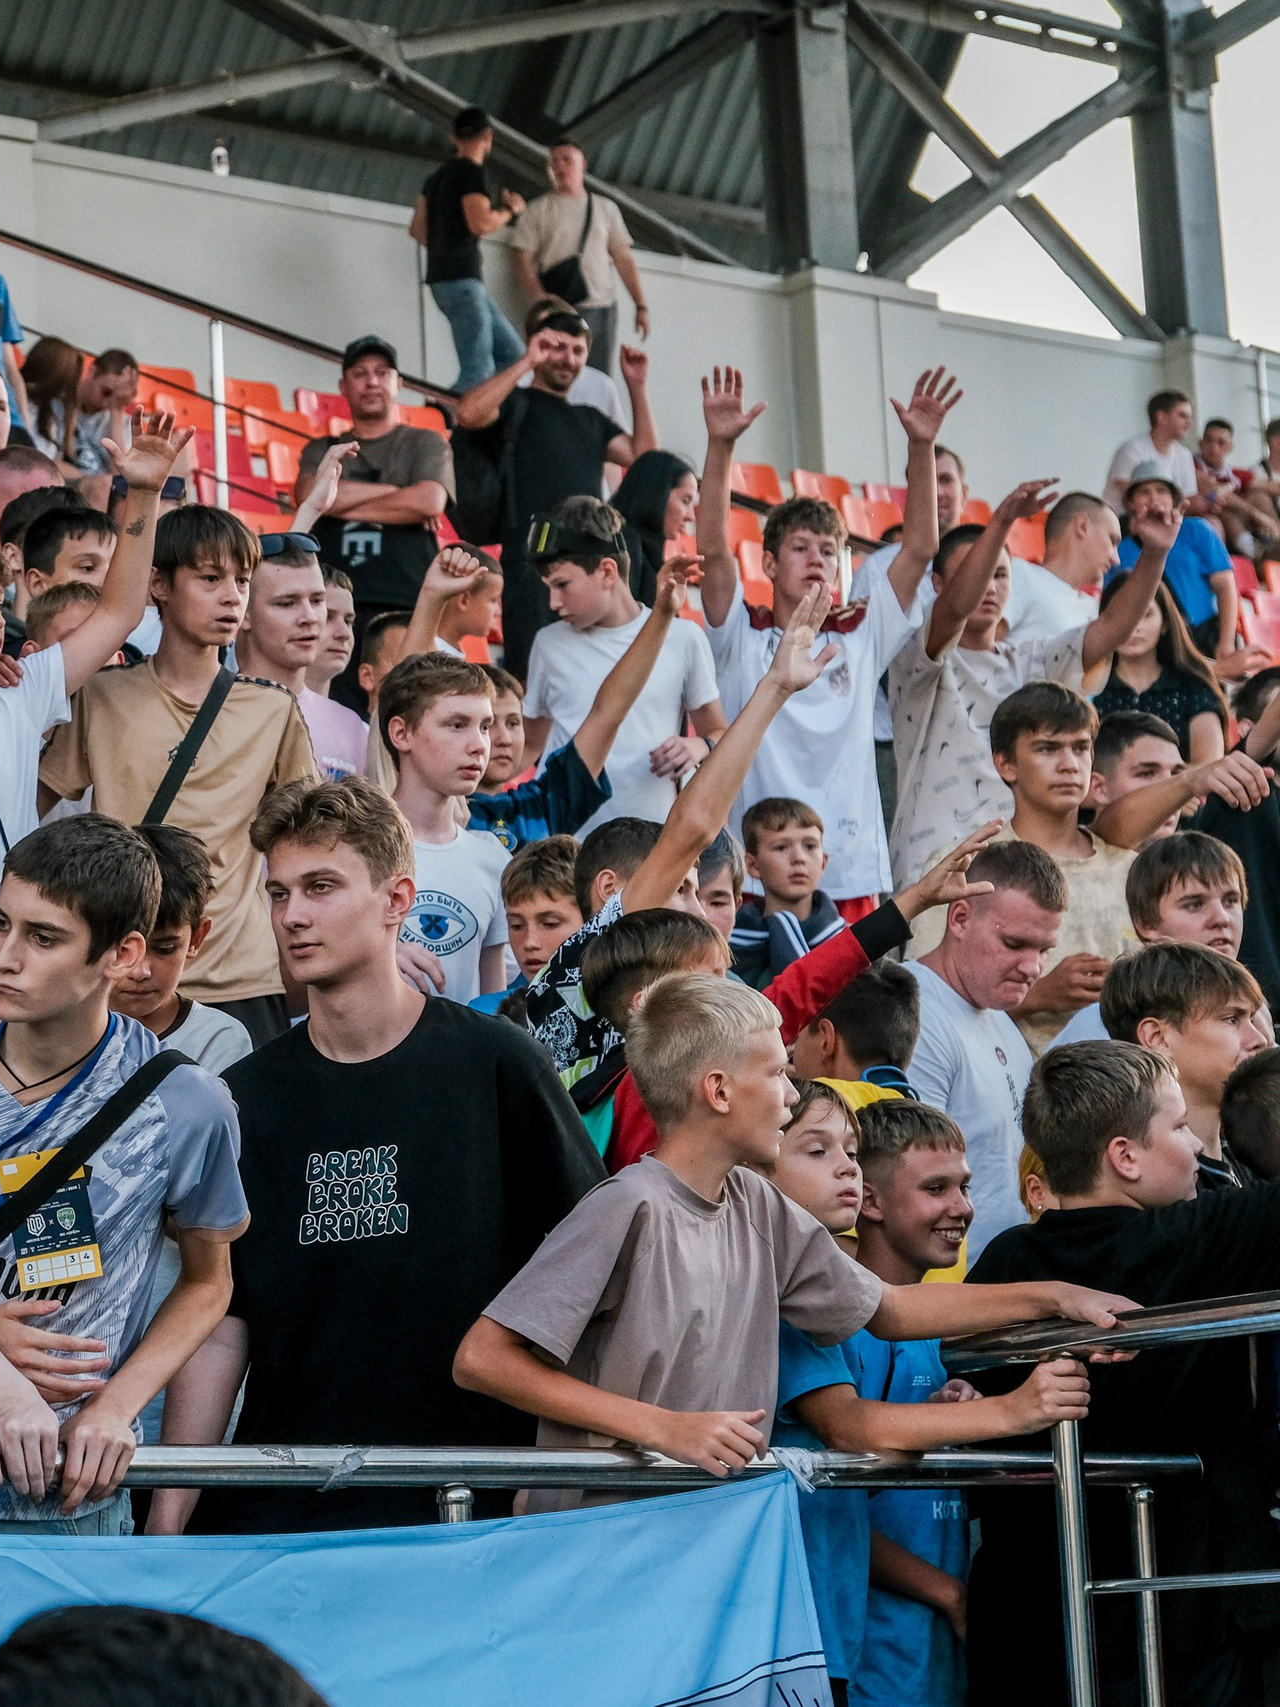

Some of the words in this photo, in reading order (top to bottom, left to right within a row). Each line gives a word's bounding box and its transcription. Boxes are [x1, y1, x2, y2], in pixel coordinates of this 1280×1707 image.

[437, 895, 463, 914] БЫТЬ
[306, 1144, 399, 1183] BREAK
[308, 1175, 398, 1213] BROKE
[299, 1203, 410, 1245] BROKEN
[27, 1263, 33, 1271] 0
[69, 1255, 76, 1263] 3
[83, 1252, 90, 1260] 4
[29, 1275, 35, 1283] 5
